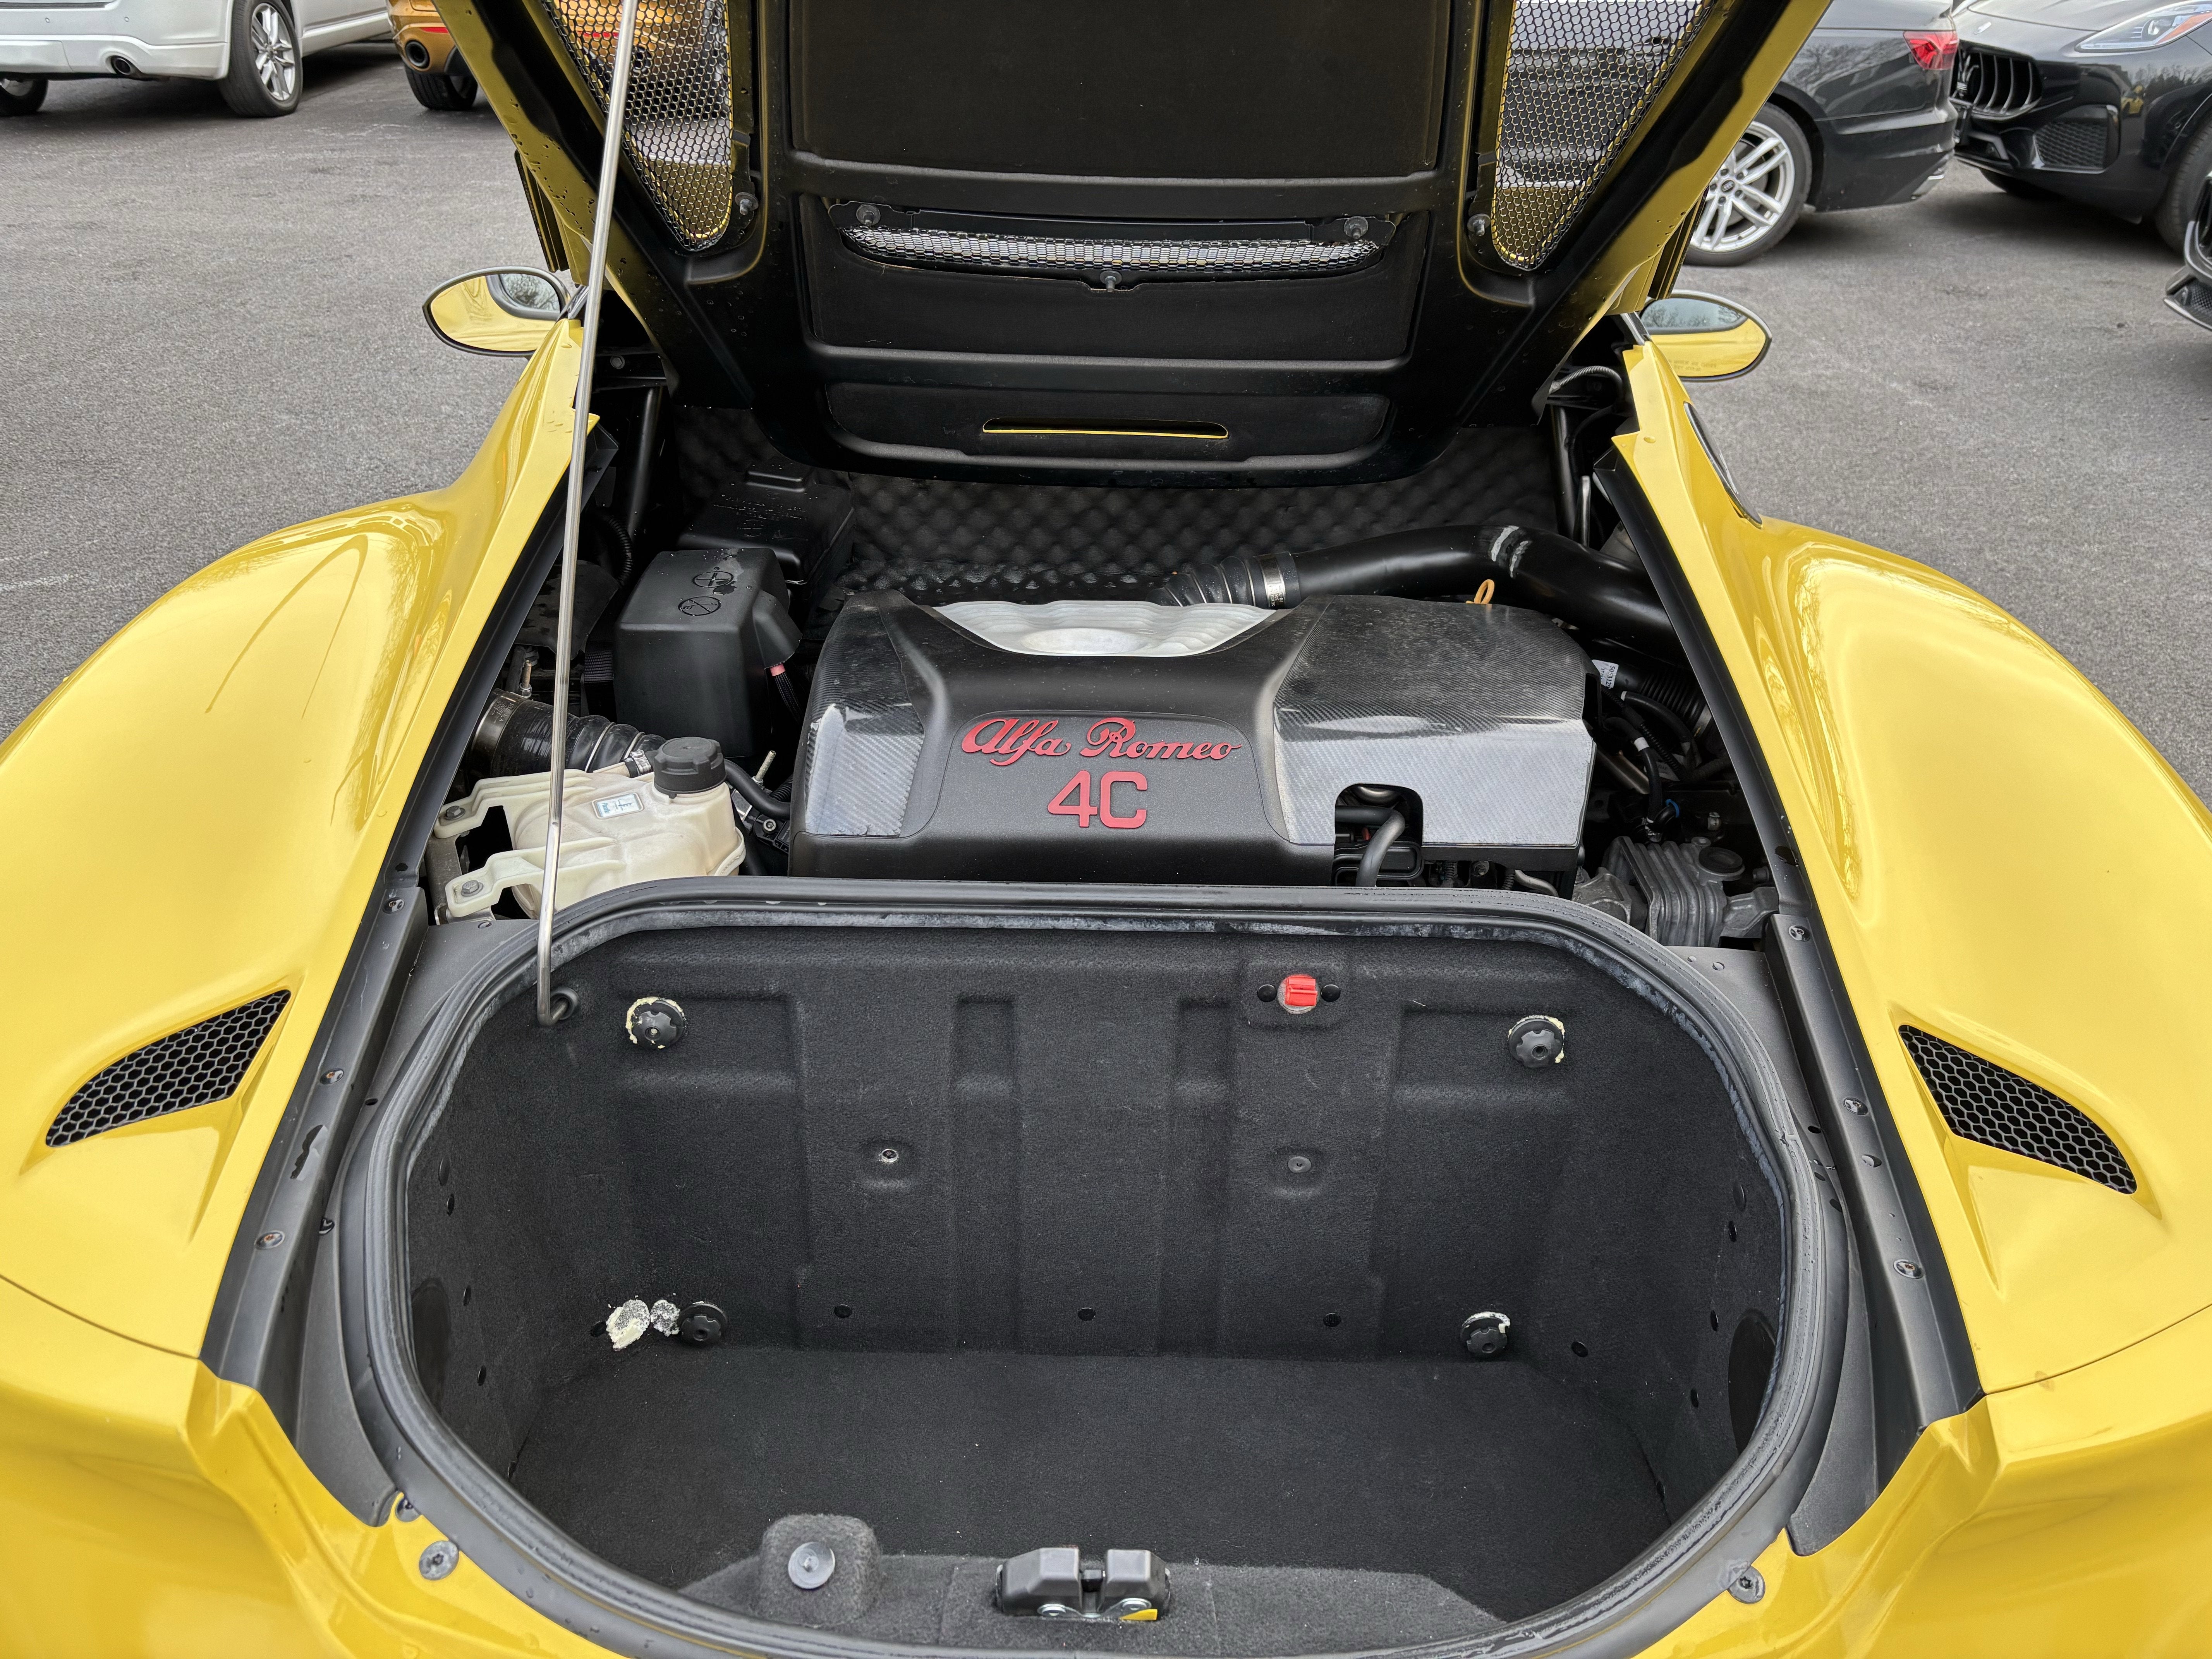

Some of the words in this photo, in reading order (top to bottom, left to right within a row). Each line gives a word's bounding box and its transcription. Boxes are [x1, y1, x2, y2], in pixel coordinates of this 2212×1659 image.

[962, 718, 1071, 766] Alfa
[1080, 717, 1242, 759] Romeo
[1048, 770, 1147, 828] 4C
